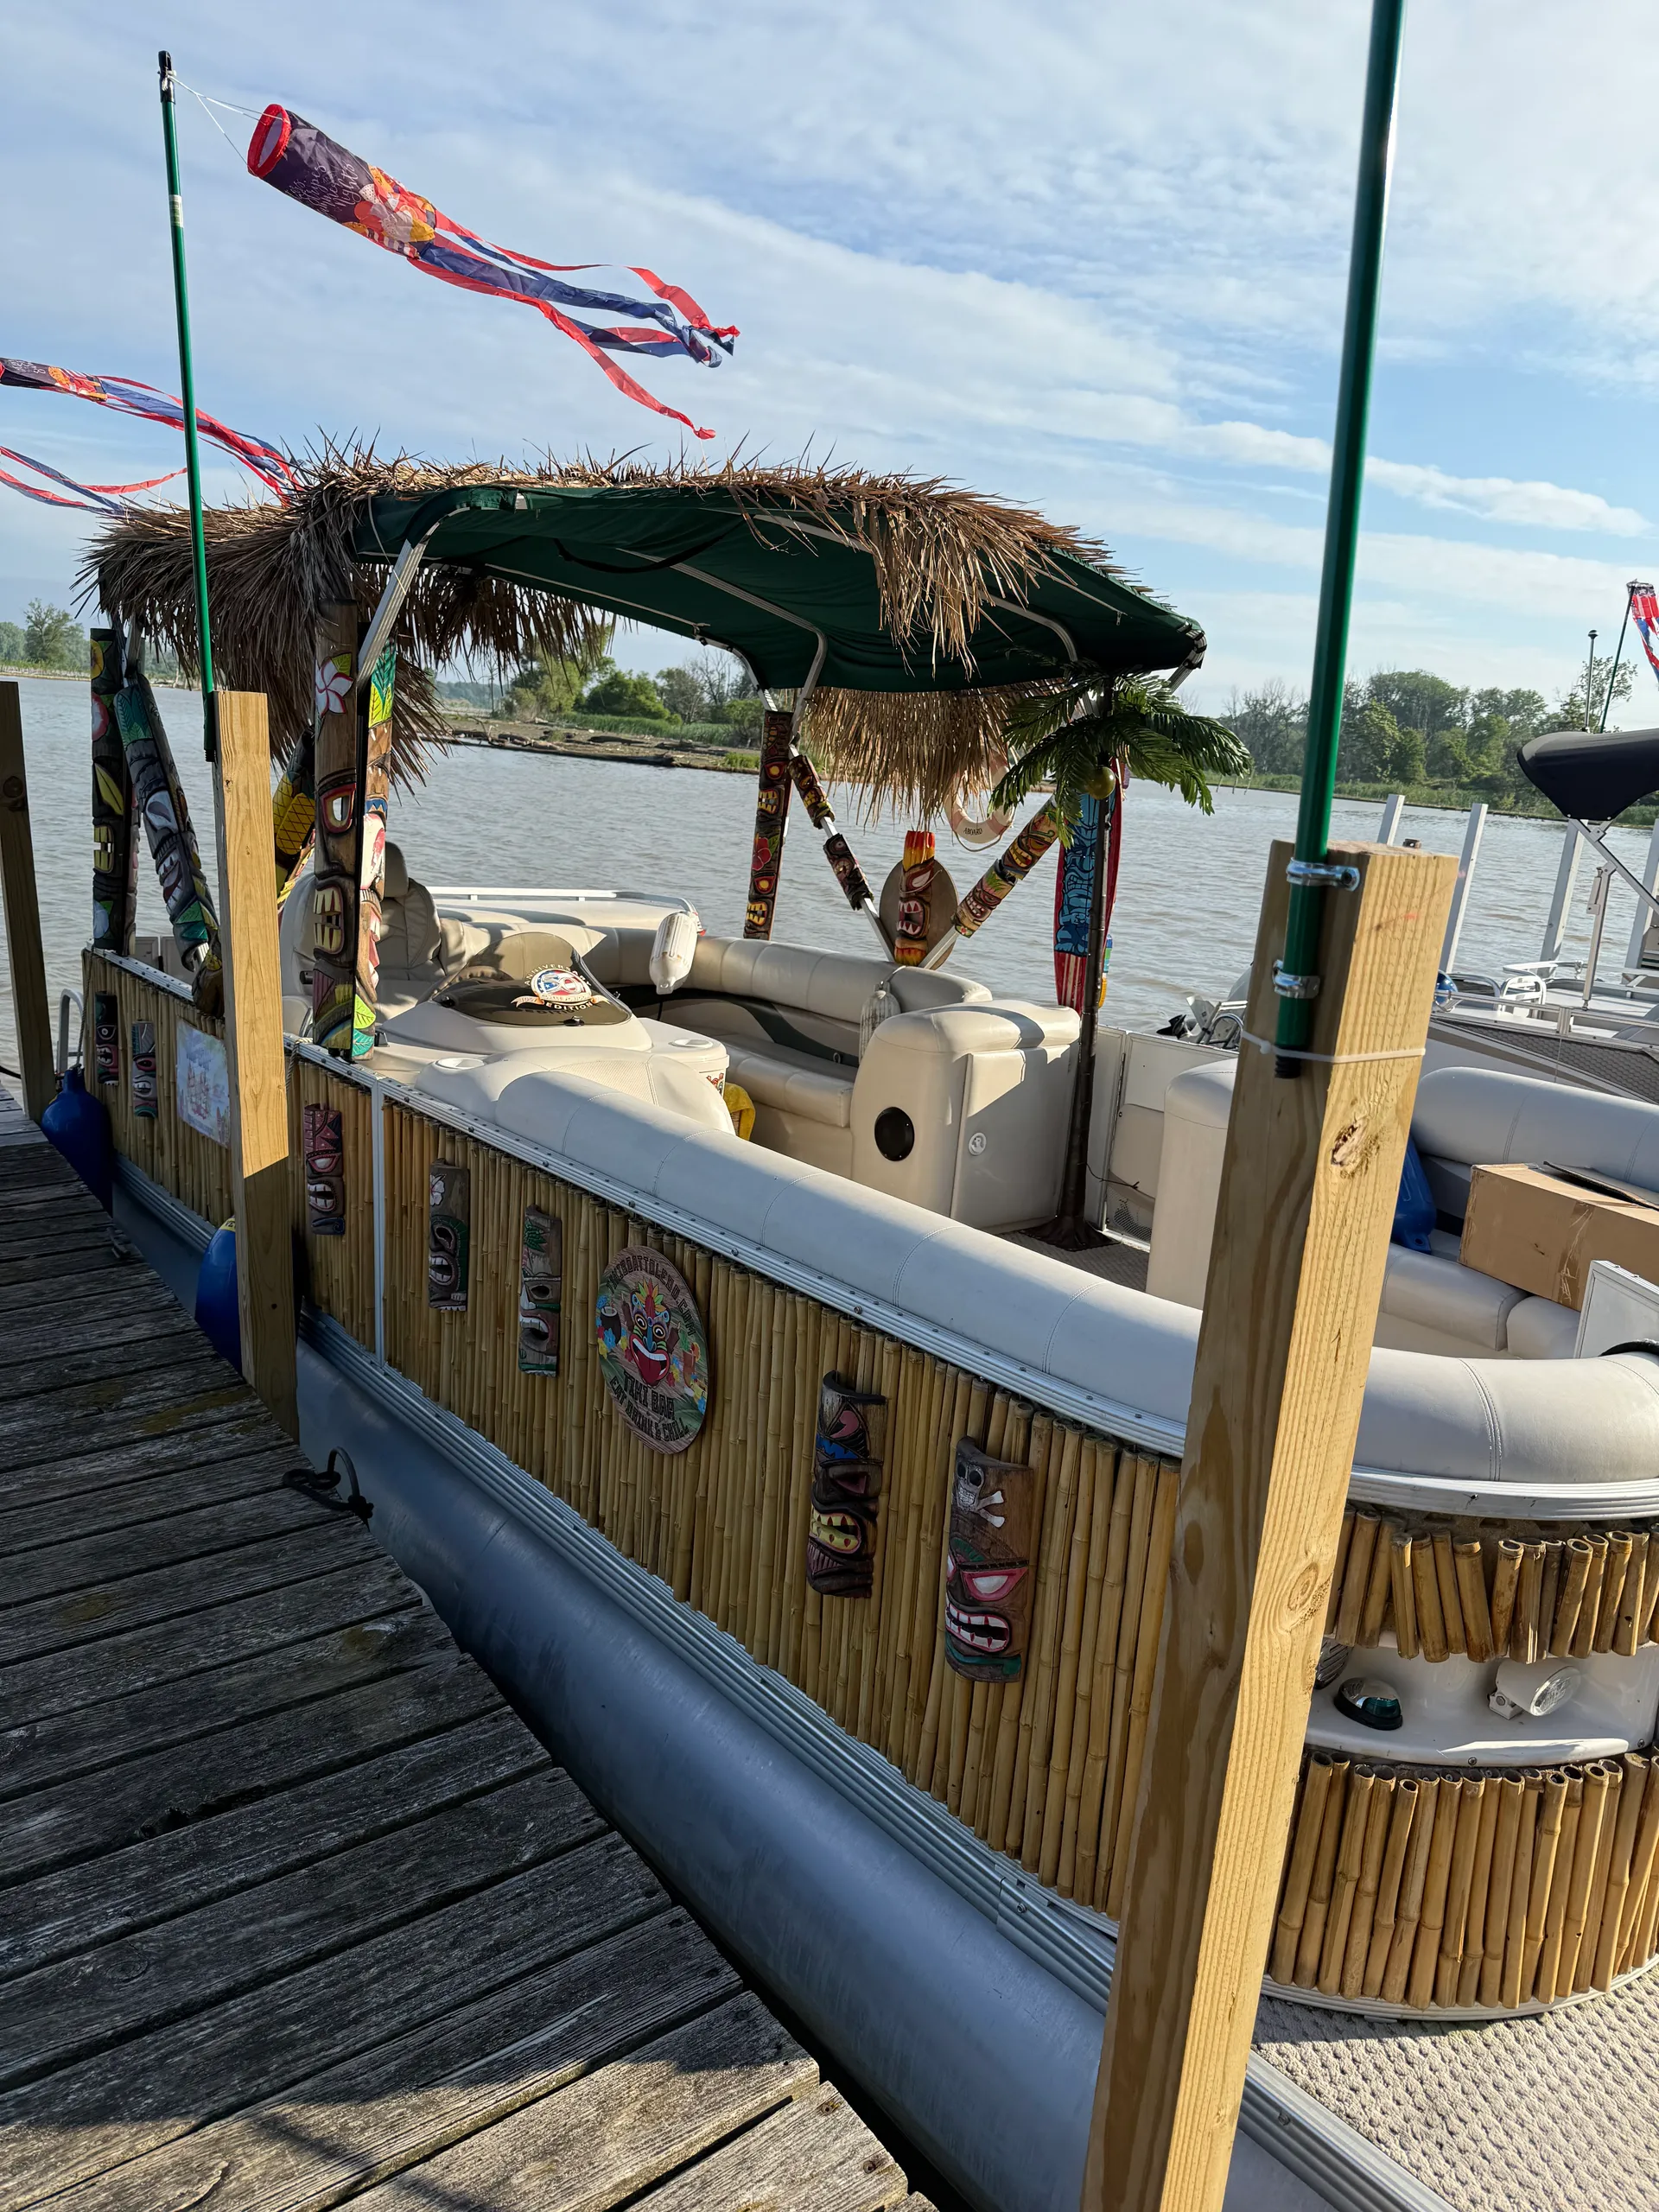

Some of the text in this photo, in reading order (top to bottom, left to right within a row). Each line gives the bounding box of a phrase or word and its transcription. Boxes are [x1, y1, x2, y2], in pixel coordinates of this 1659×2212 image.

[963, 827, 982, 836] ABOARD
[524, 963, 592, 987] ANNIVERSARY
[546, 1001, 594, 1011] EDITION
[607, 1255, 696, 1336] TIKIBOATTOLEDO.COM
[609, 1376, 690, 1441] EAT DRINK & CHILL
[624, 1371, 675, 1421] TIKI BAR
